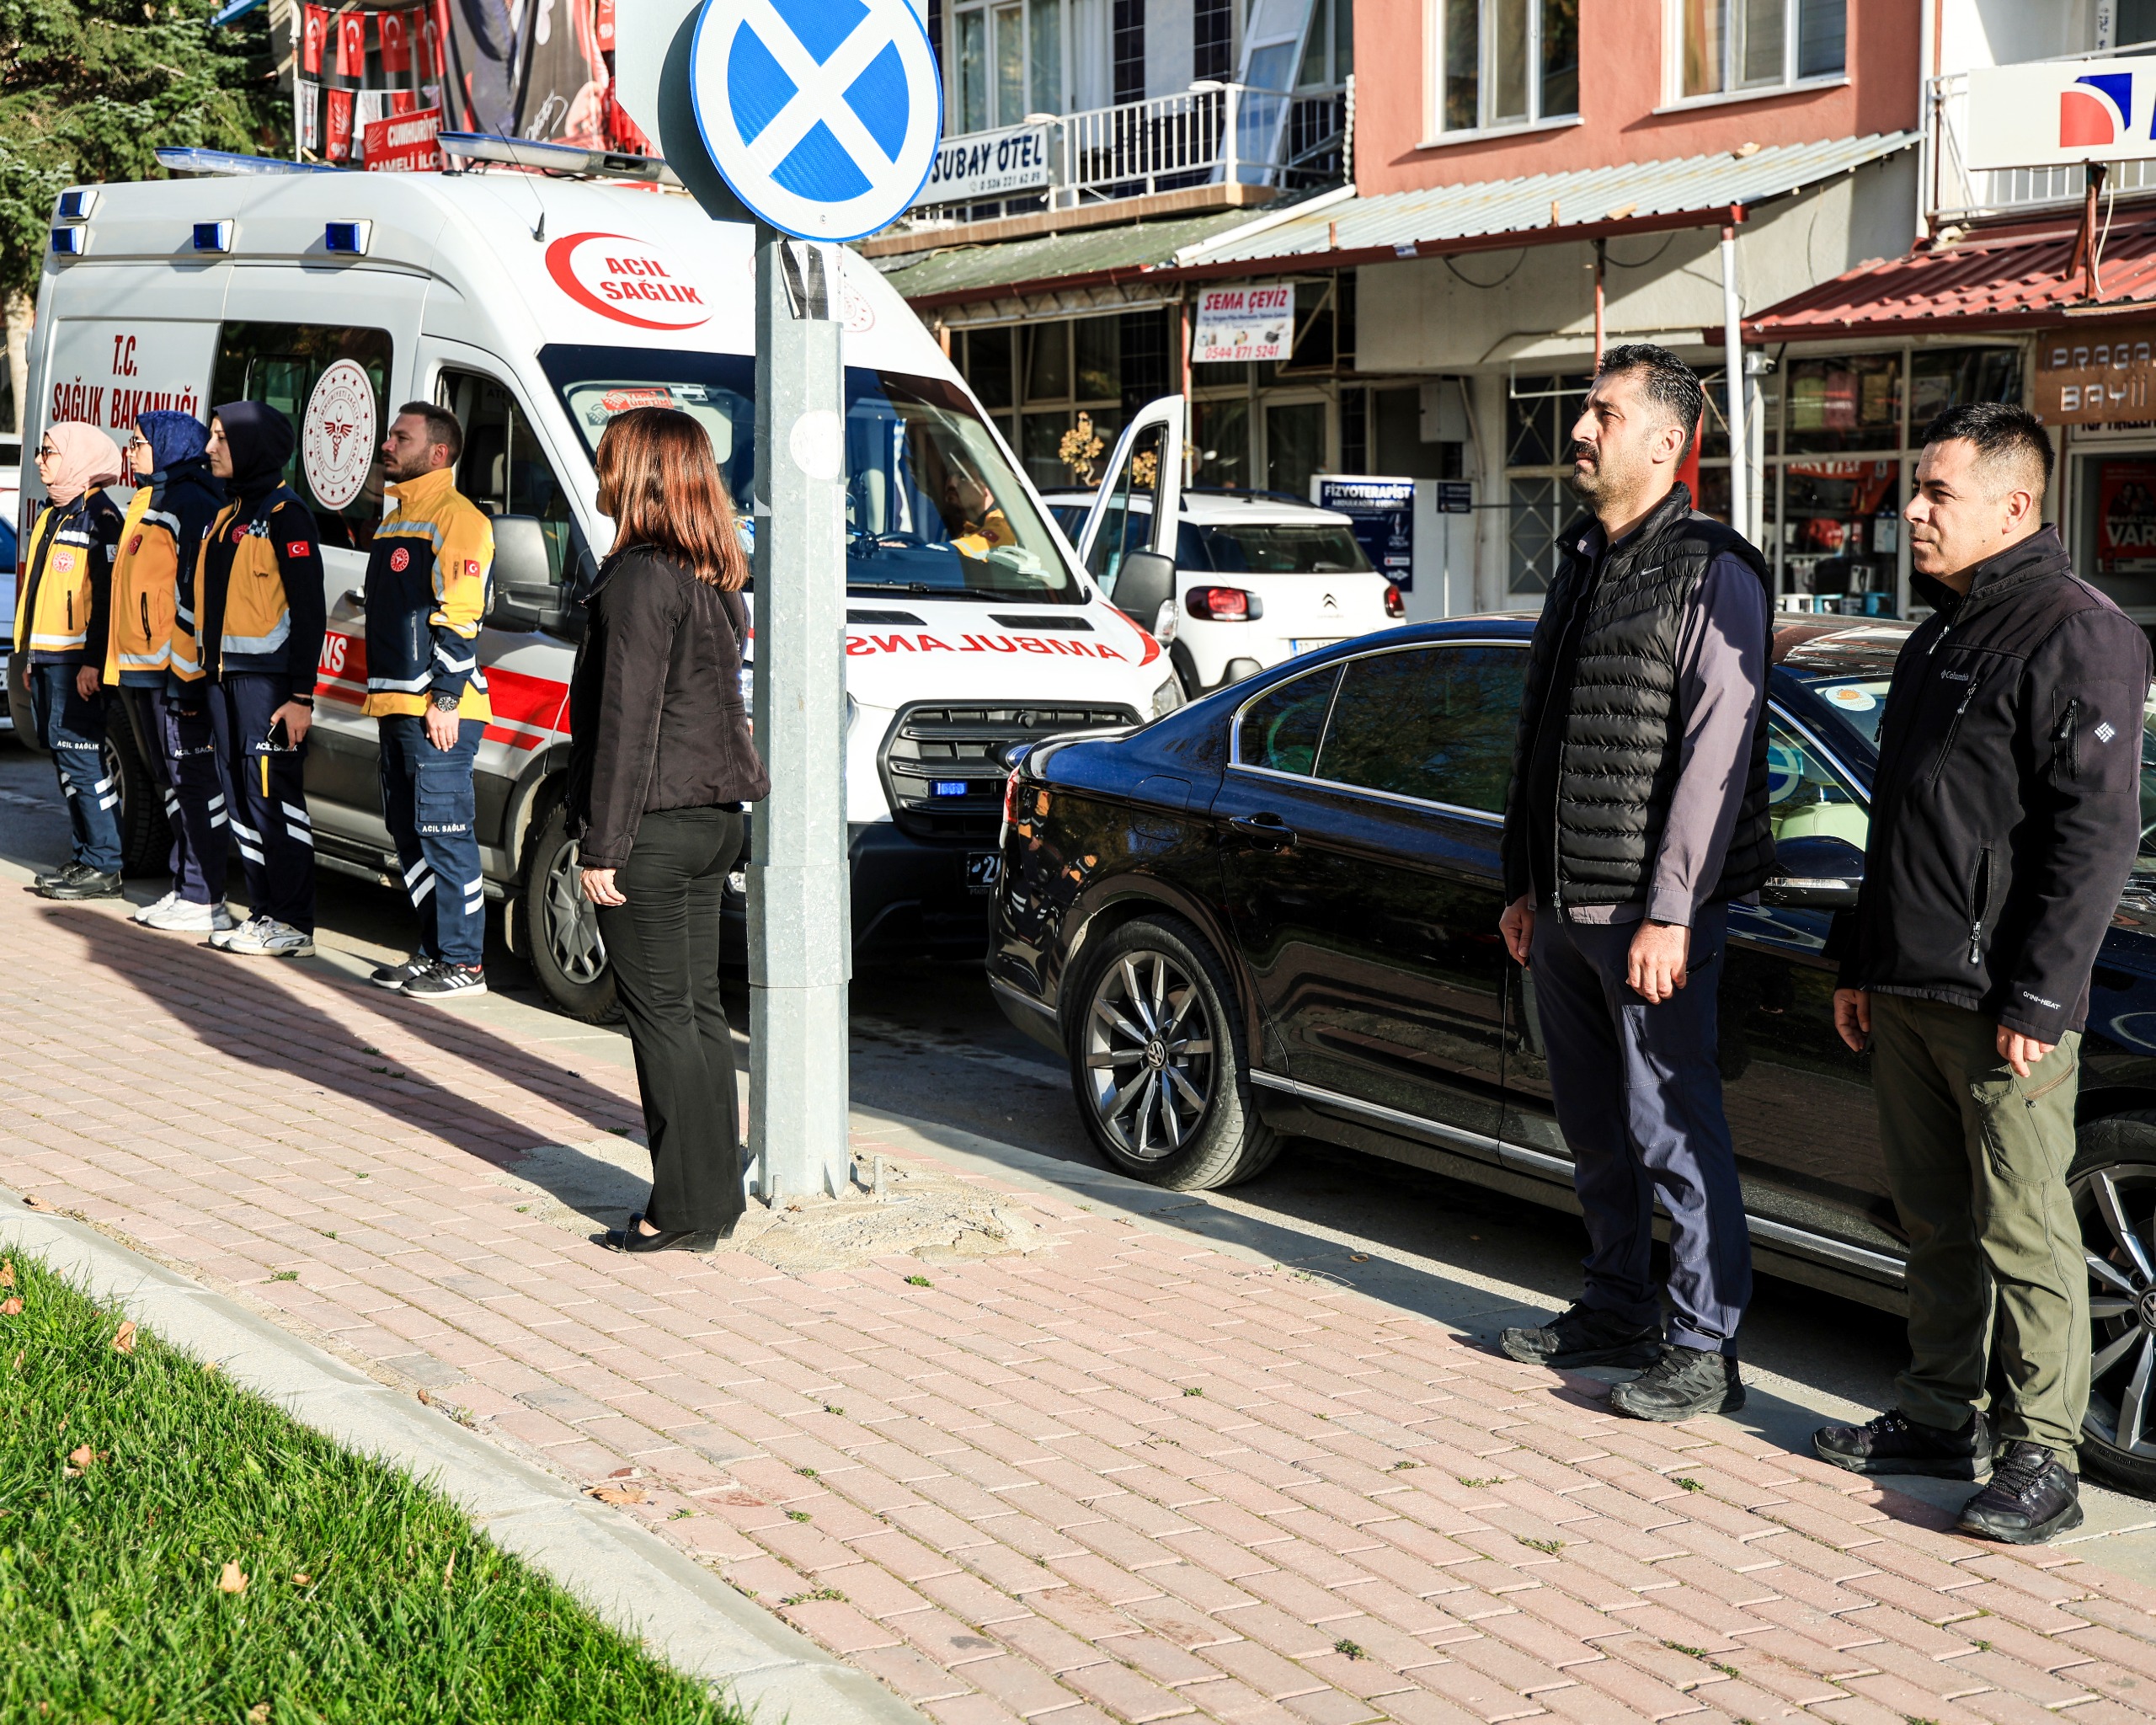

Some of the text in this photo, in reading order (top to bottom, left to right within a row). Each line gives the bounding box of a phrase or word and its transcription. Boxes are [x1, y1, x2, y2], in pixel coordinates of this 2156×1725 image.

[932, 134, 1042, 183] SUBAY OTEL
[606, 257, 670, 278] ACİL
[600, 279, 705, 305] SAĞLIK
[1204, 285, 1288, 314] SEMA ÇEYİZ
[112, 334, 137, 377] T.C.
[1205, 344, 1279, 359] 0544 871 5241
[52, 376, 104, 426] SAĞLIK
[1325, 483, 1412, 499] FİZYOTERAPİST
